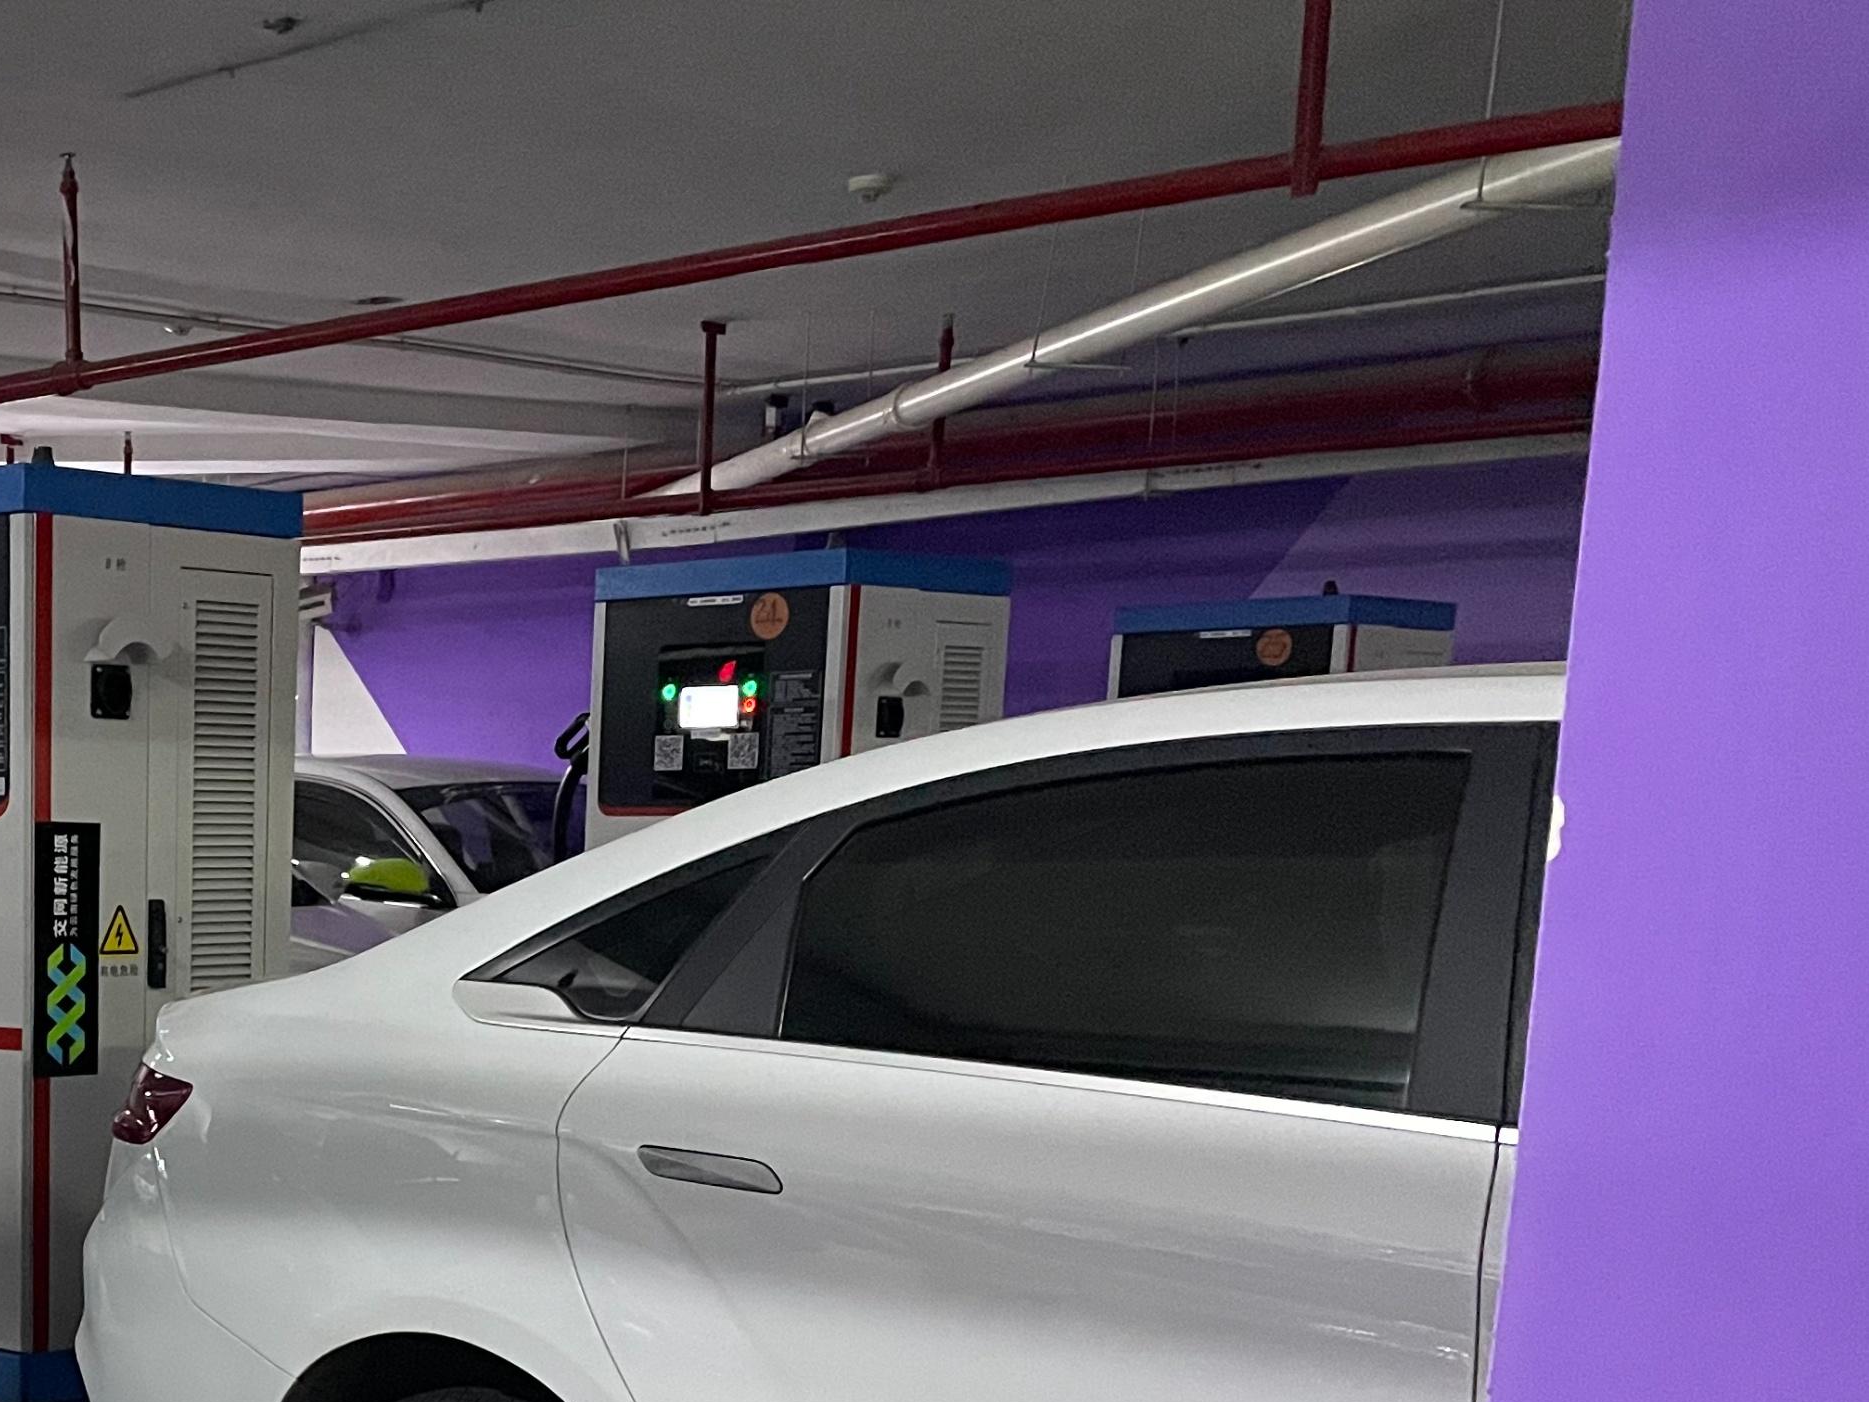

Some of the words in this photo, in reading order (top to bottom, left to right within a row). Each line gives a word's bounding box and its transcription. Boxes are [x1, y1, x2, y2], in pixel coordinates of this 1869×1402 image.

[52, 833, 69, 939] 交网新能源
